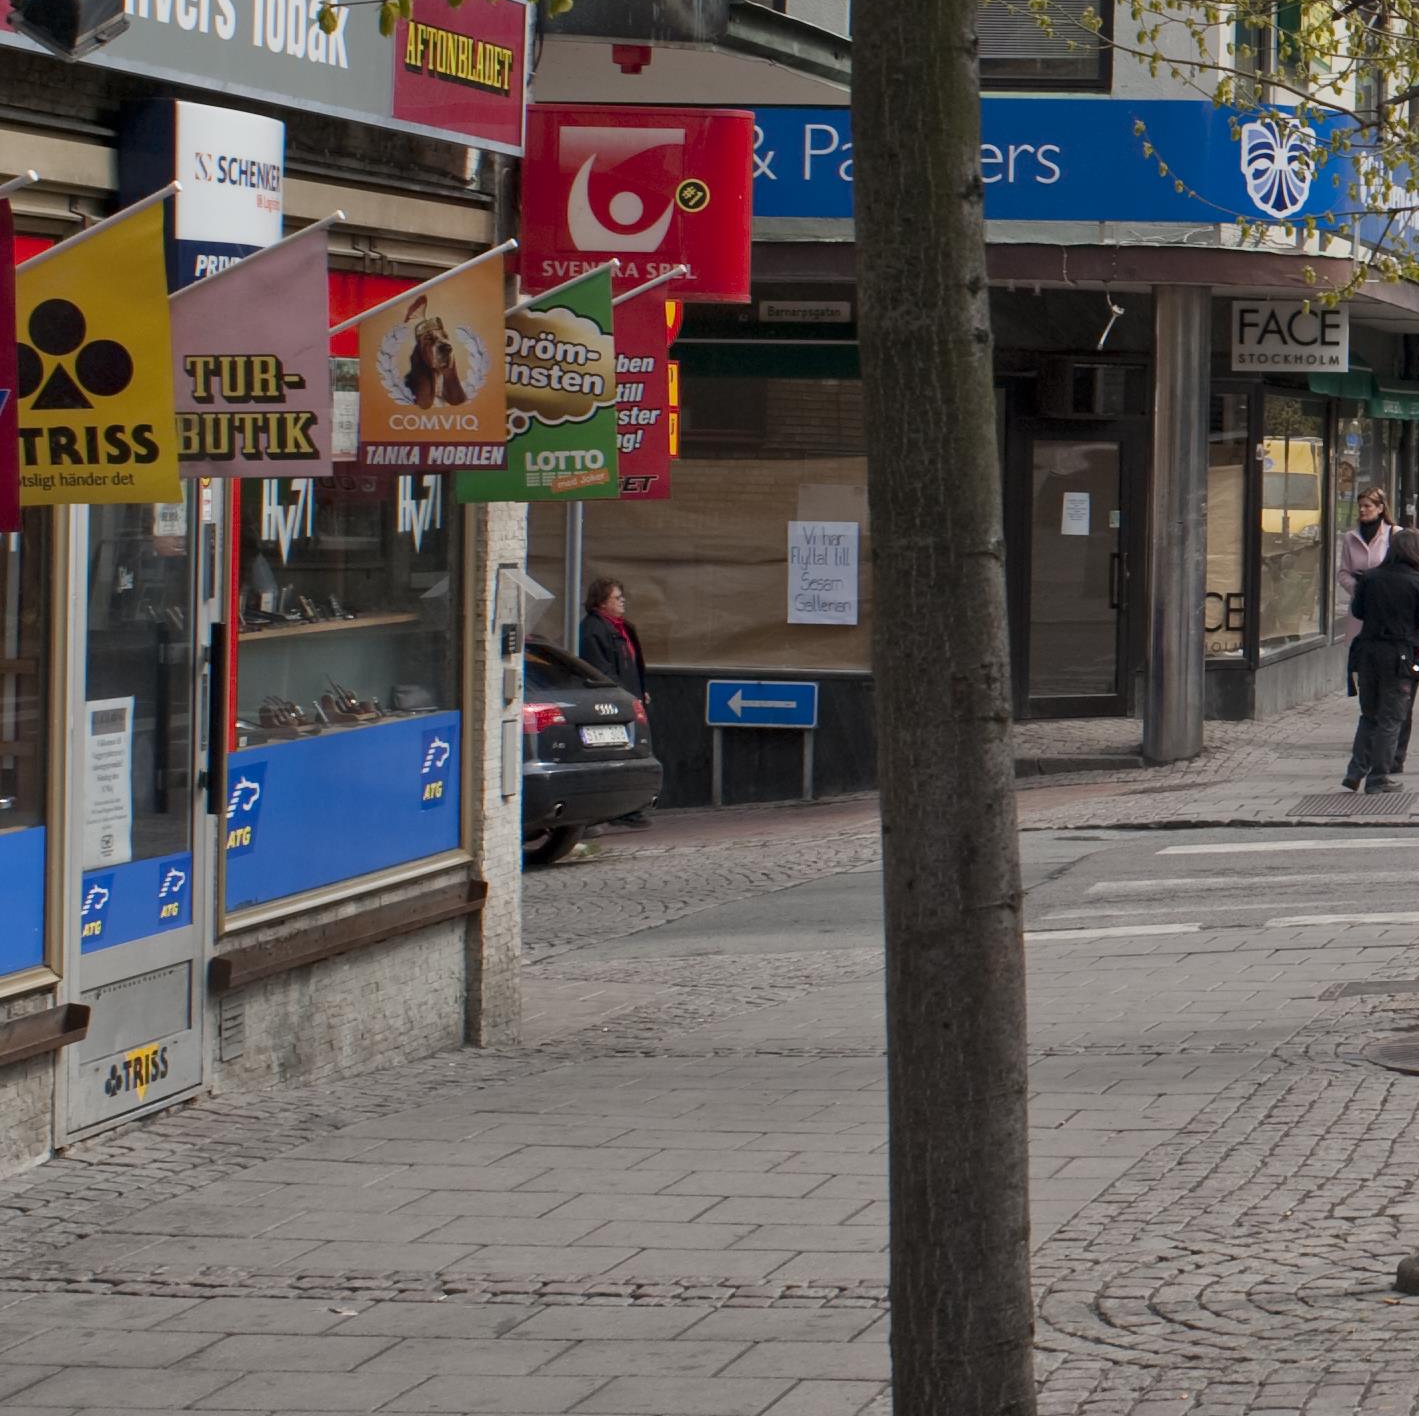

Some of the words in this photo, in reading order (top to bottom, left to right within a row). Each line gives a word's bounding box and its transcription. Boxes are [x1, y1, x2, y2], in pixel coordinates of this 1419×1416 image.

[405, 21, 513, 93] AFTONBLADET
[542, 260, 639, 278] SVENKA
[1238, 309, 1340, 346] FACE
[504, 329, 601, 365] Dröm-
[1238, 353, 1340, 366] STOCKHOLM
[185, 354, 305, 403] TUR-
[505, 356, 605, 395] insten
[389, 414, 479, 431] COMVIQ
[19, 424, 160, 466] TRISS
[174, 411, 320, 461] BUTIK
[366, 446, 420, 465] TANKA
[427, 445, 504, 465] MOBILEN
[525, 449, 605, 471] LOTTO
[60, 473, 109, 486] händer
[113, 472, 135, 485] det
[422, 780, 444, 801] ATG
[226, 825, 251, 850] ATG
[159, 902, 178, 919] ATG
[82, 920, 102, 938] ATG
[121, 1047, 168, 1092] TRISS
